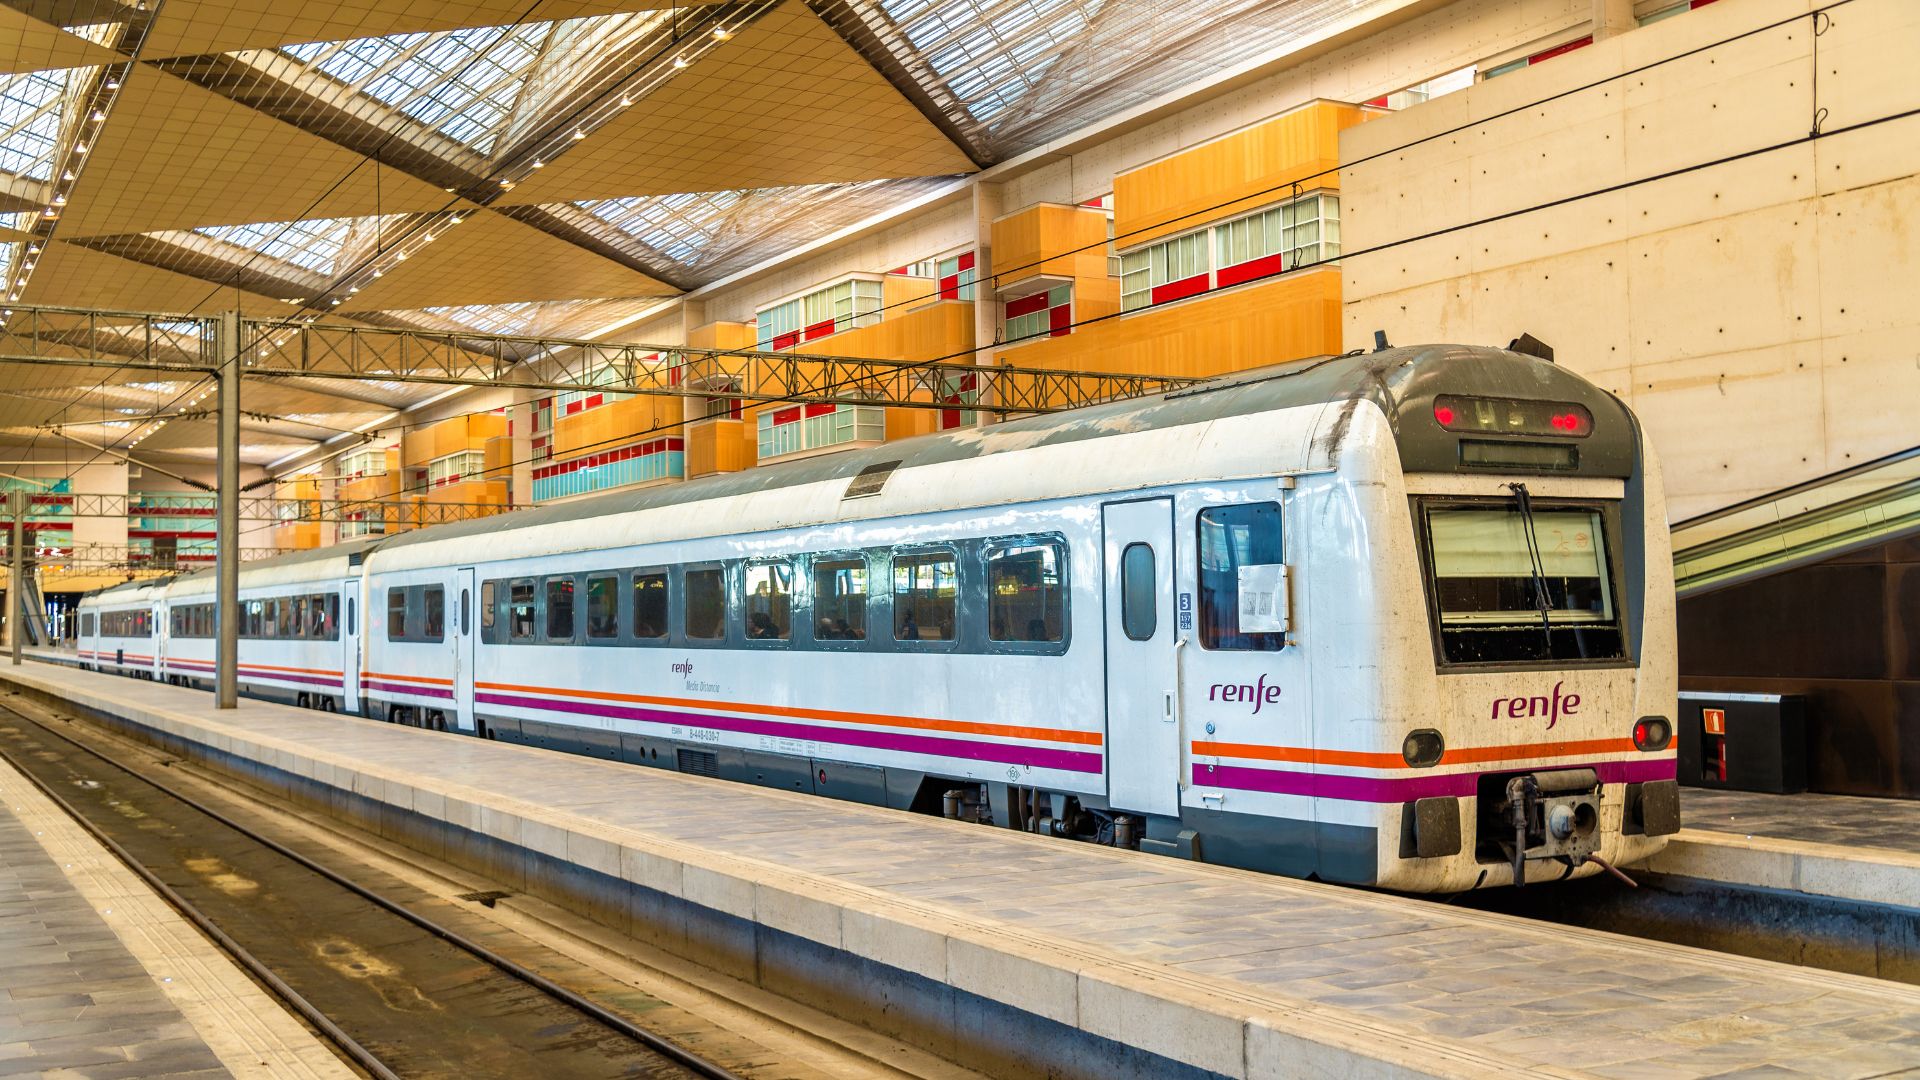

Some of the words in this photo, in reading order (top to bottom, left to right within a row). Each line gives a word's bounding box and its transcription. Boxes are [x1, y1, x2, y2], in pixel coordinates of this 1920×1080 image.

[1182, 597, 1189, 610] 3
[671, 658, 693, 680] renfe
[1209, 673, 1281, 715] renfe
[1491, 680, 1581, 731] renfe
